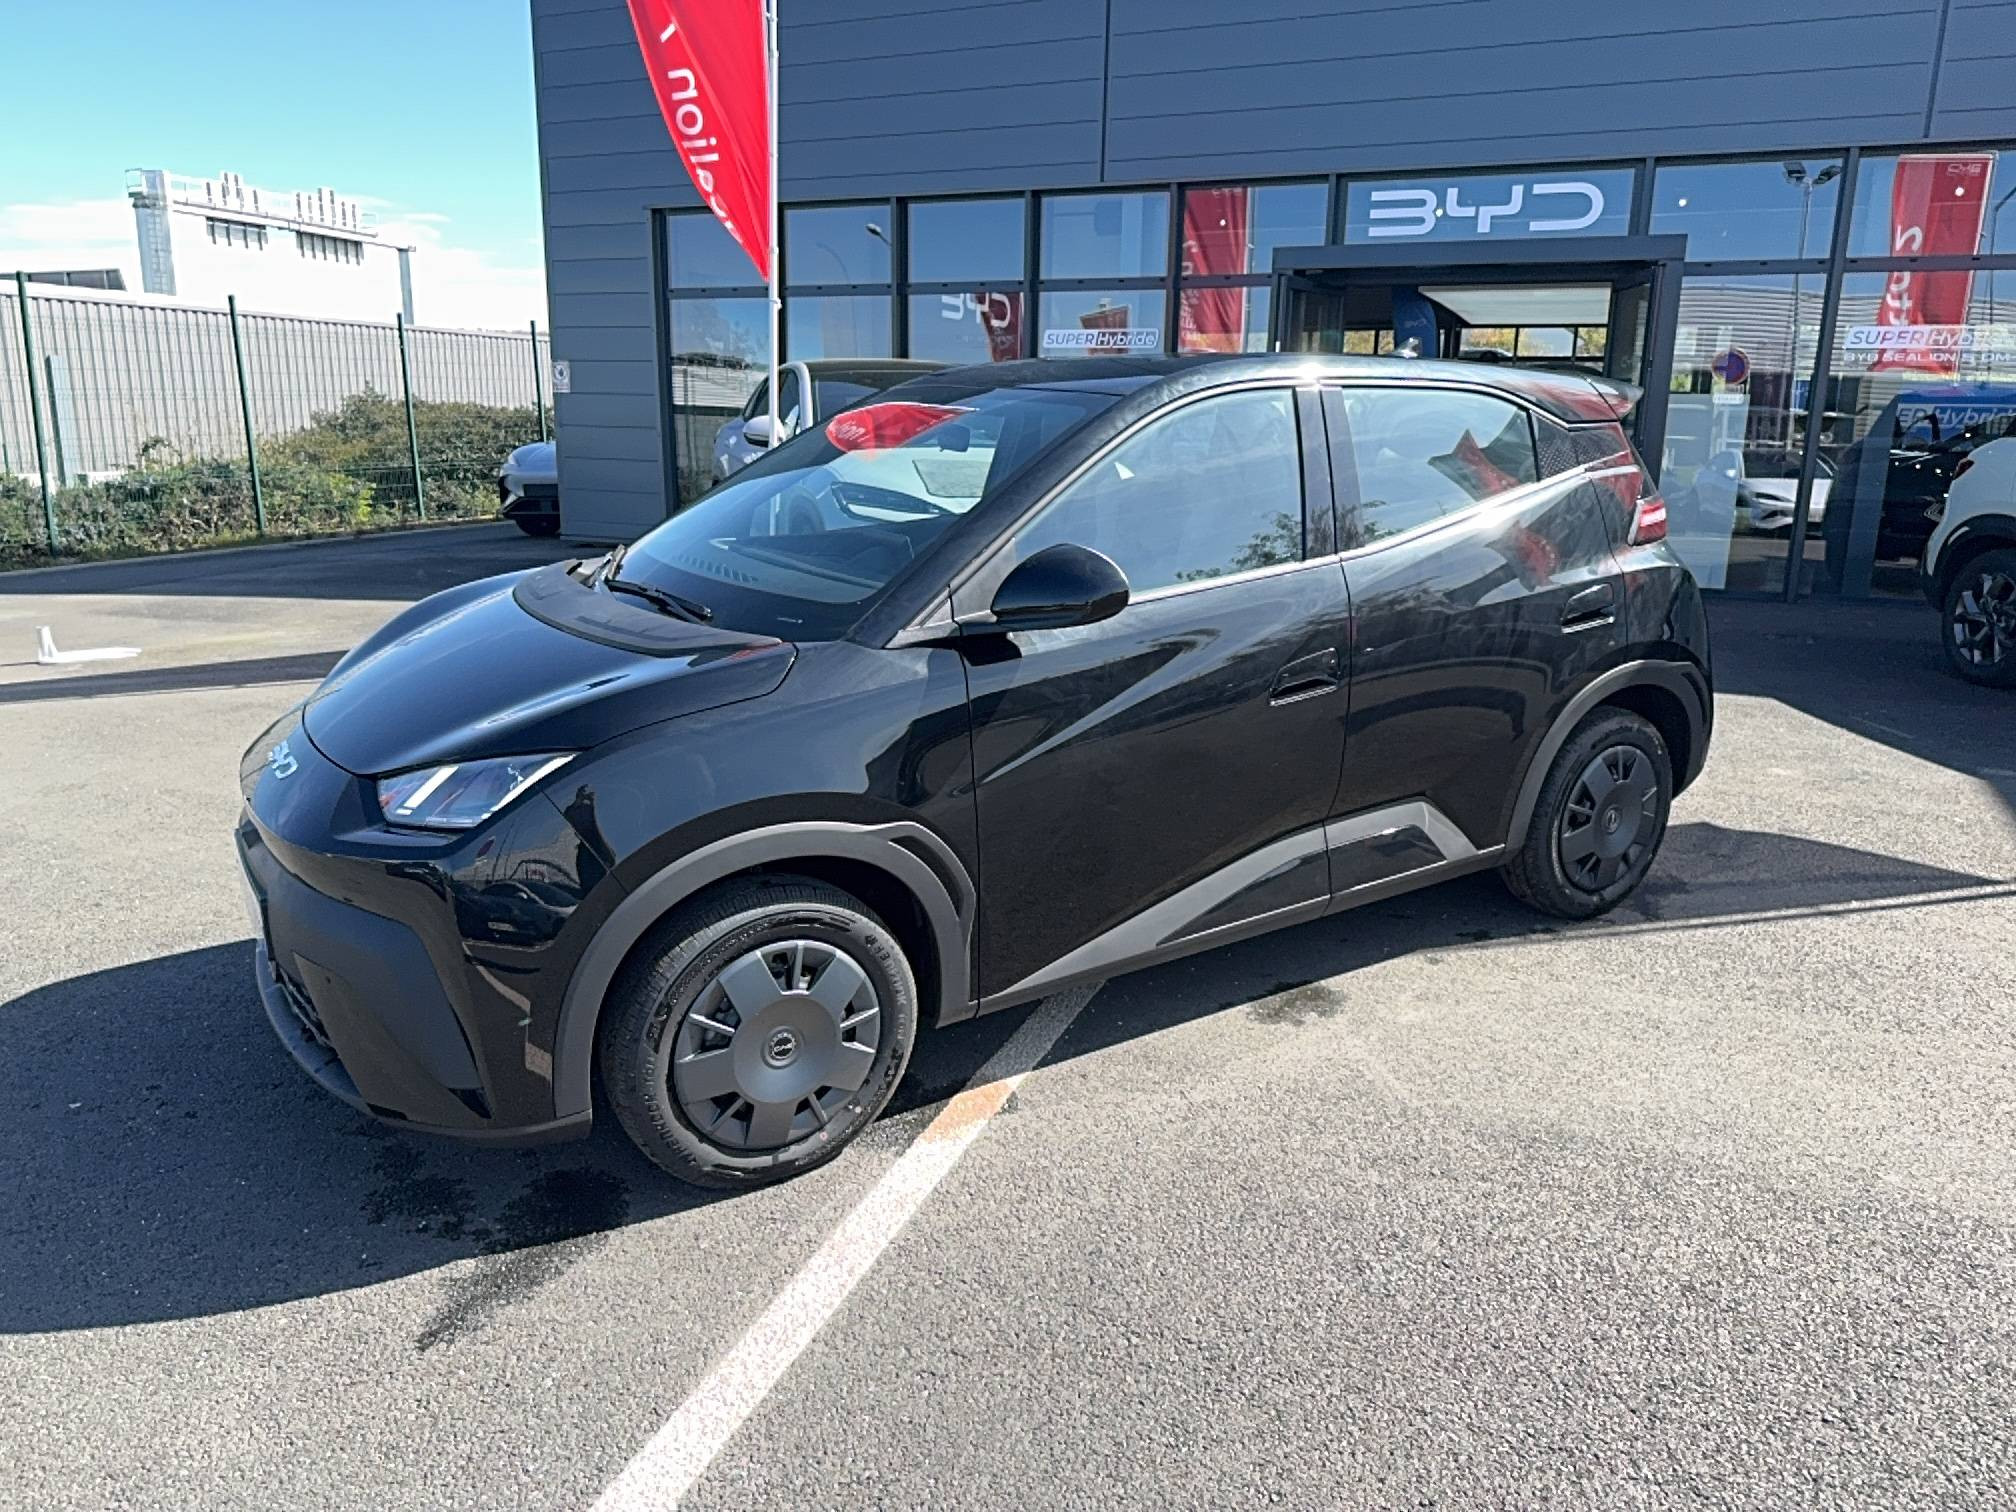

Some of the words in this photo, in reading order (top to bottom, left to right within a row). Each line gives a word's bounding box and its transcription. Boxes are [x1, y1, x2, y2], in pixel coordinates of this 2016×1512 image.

[1367, 182, 1605, 237] BYD
[1045, 333, 1096, 346] SUPER
[1097, 331, 1157, 347] Hybride
[1850, 330, 1925, 345] SUPER
